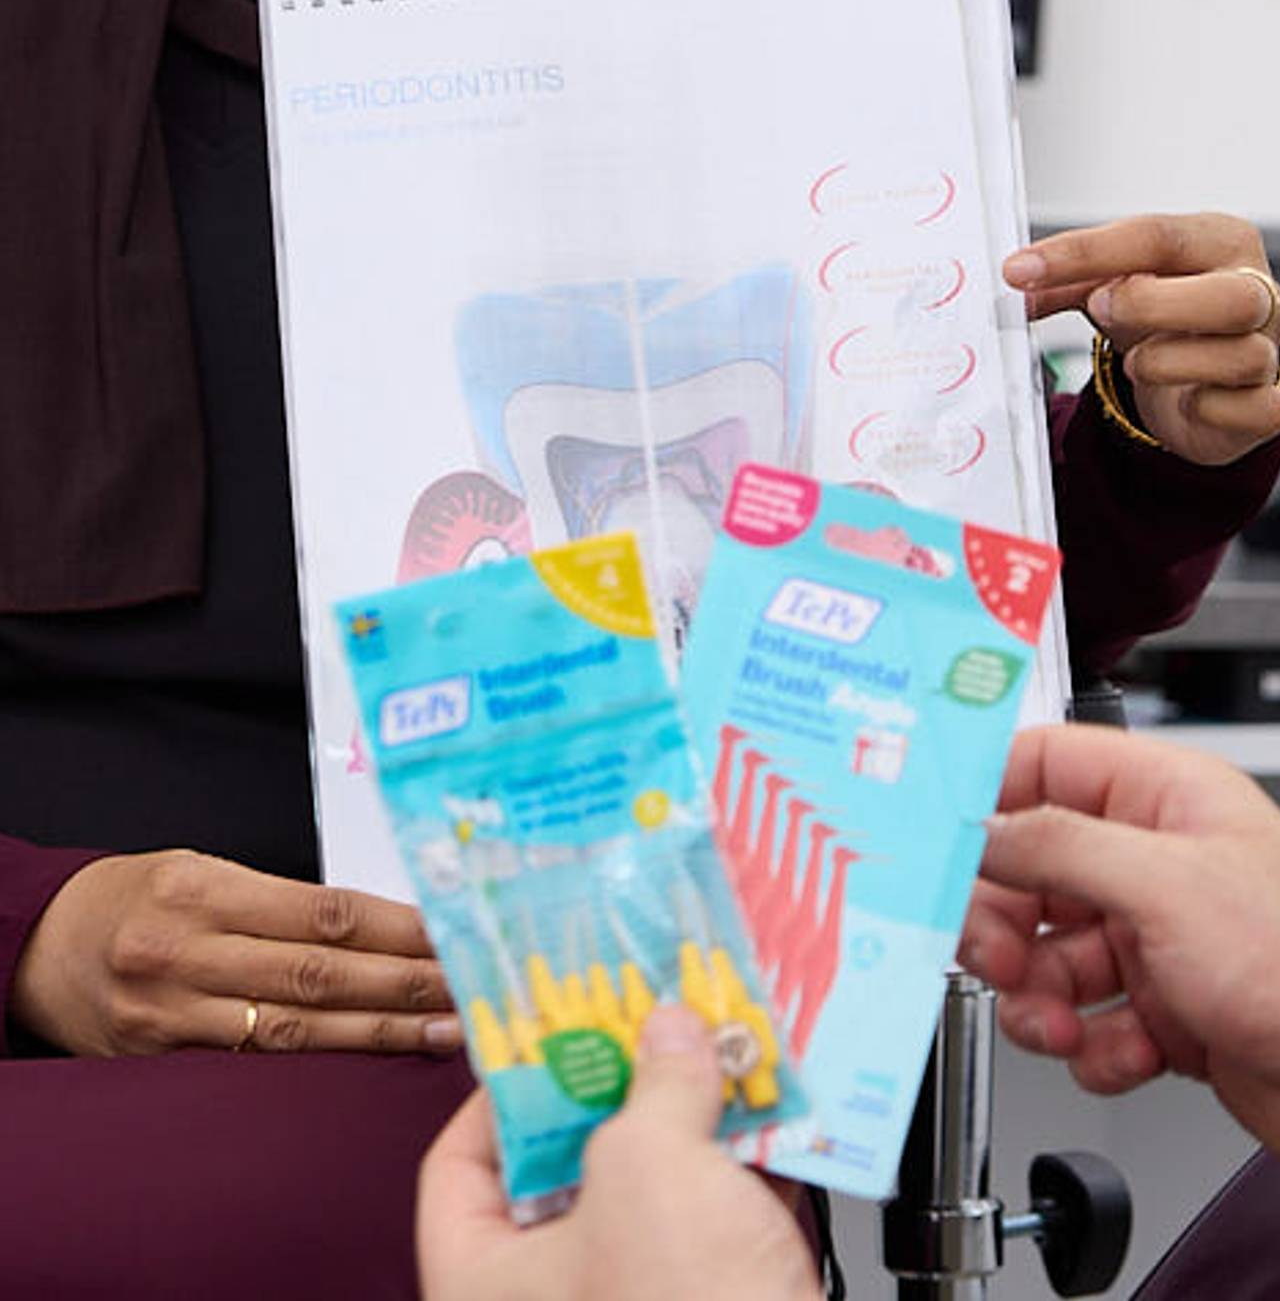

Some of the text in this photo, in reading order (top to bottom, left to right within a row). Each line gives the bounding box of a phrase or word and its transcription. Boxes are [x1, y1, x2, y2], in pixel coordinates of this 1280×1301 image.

[288, 64, 565, 114] PERIODONTITIS
[1007, 564, 1032, 594] 2
[785, 587, 864, 632] TePe
[478, 636, 619, 692] Interdental
[741, 656, 828, 702] Brush
[749, 629, 911, 692] Interdental
[487, 684, 566, 723] Brush
